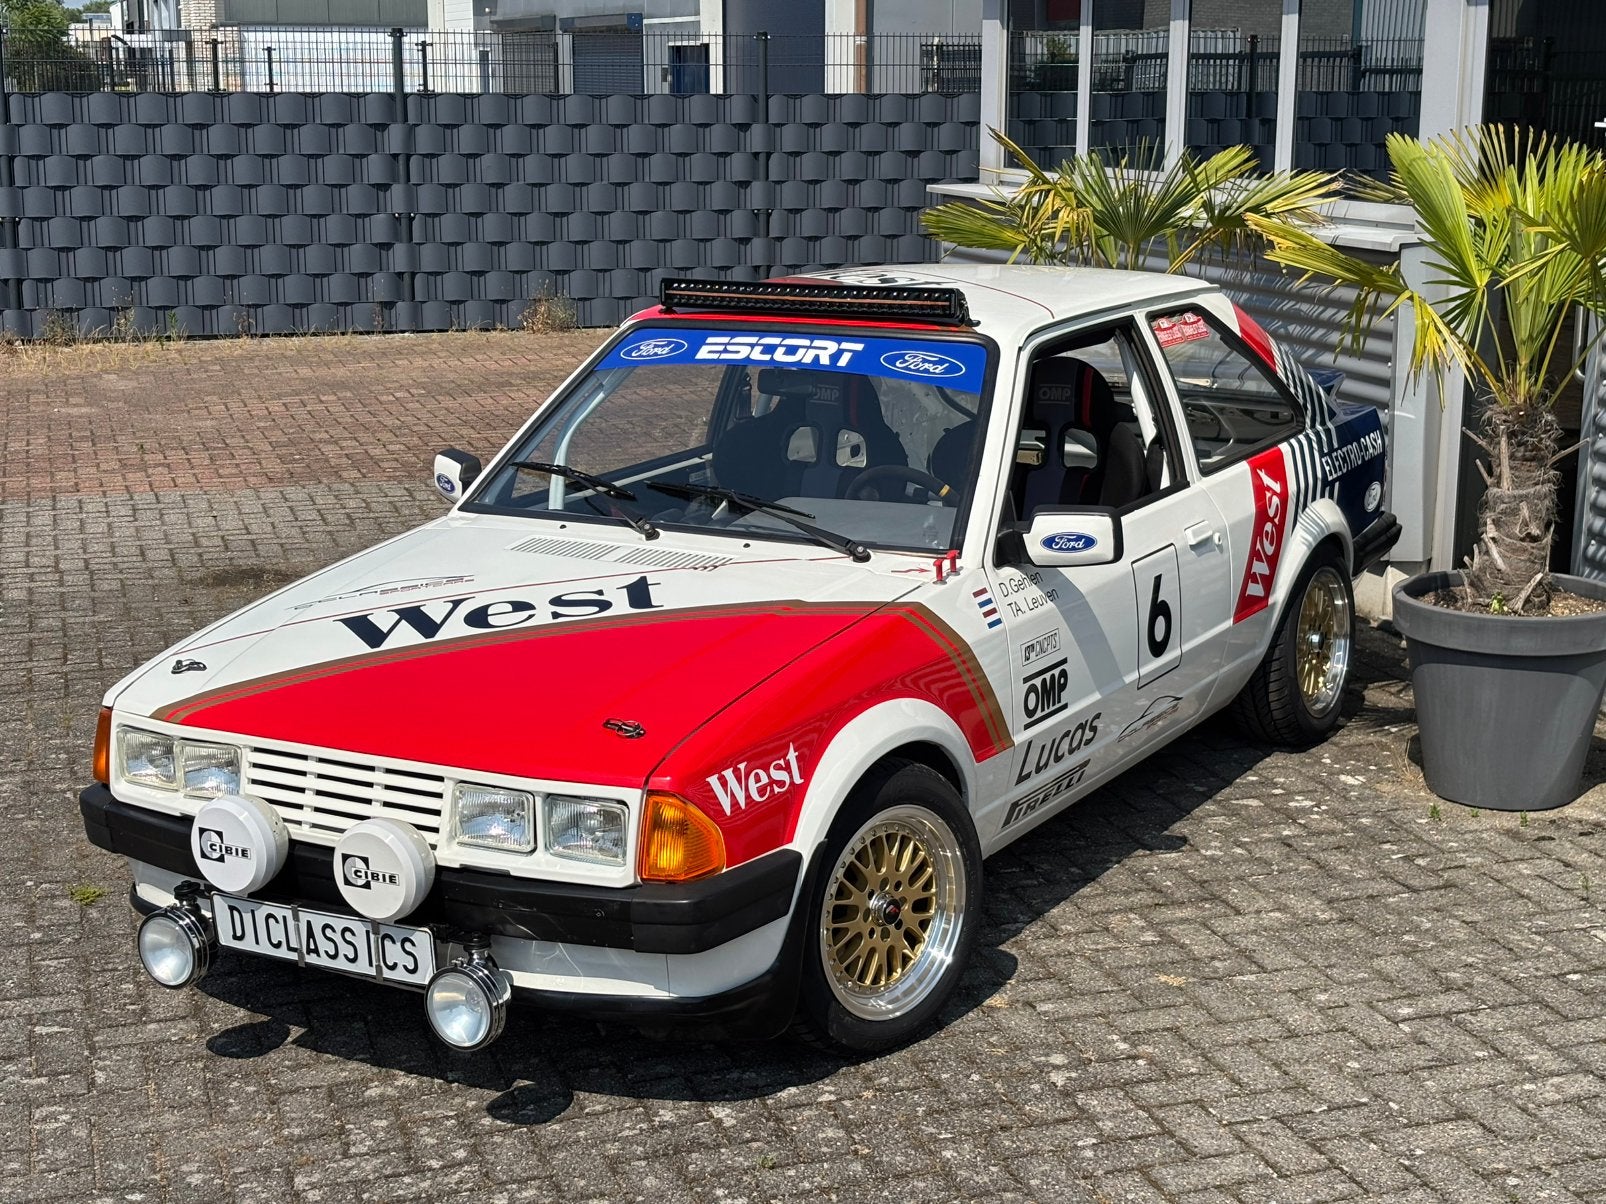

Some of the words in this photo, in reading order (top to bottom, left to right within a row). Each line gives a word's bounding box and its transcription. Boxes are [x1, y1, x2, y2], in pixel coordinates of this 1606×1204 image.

[632, 341, 671, 357] Ford
[695, 336, 864, 367] ESCORT
[895, 353, 948, 374] Ford
[1040, 387, 1071, 400] OMP
[1321, 429, 1383, 481] ELECTRO-CASH
[1052, 535, 1086, 549] Ford
[1246, 468, 1281, 597] West
[998, 571, 1043, 598] D.Gehlen
[1024, 588, 1059, 611] Leuven
[333, 575, 665, 649] West
[1147, 573, 1172, 658] 6
[1023, 668, 1069, 719] OMP
[1015, 712, 1102, 786] Lucas
[706, 742, 804, 816] West
[1001, 759, 1091, 829] PIRELLI
